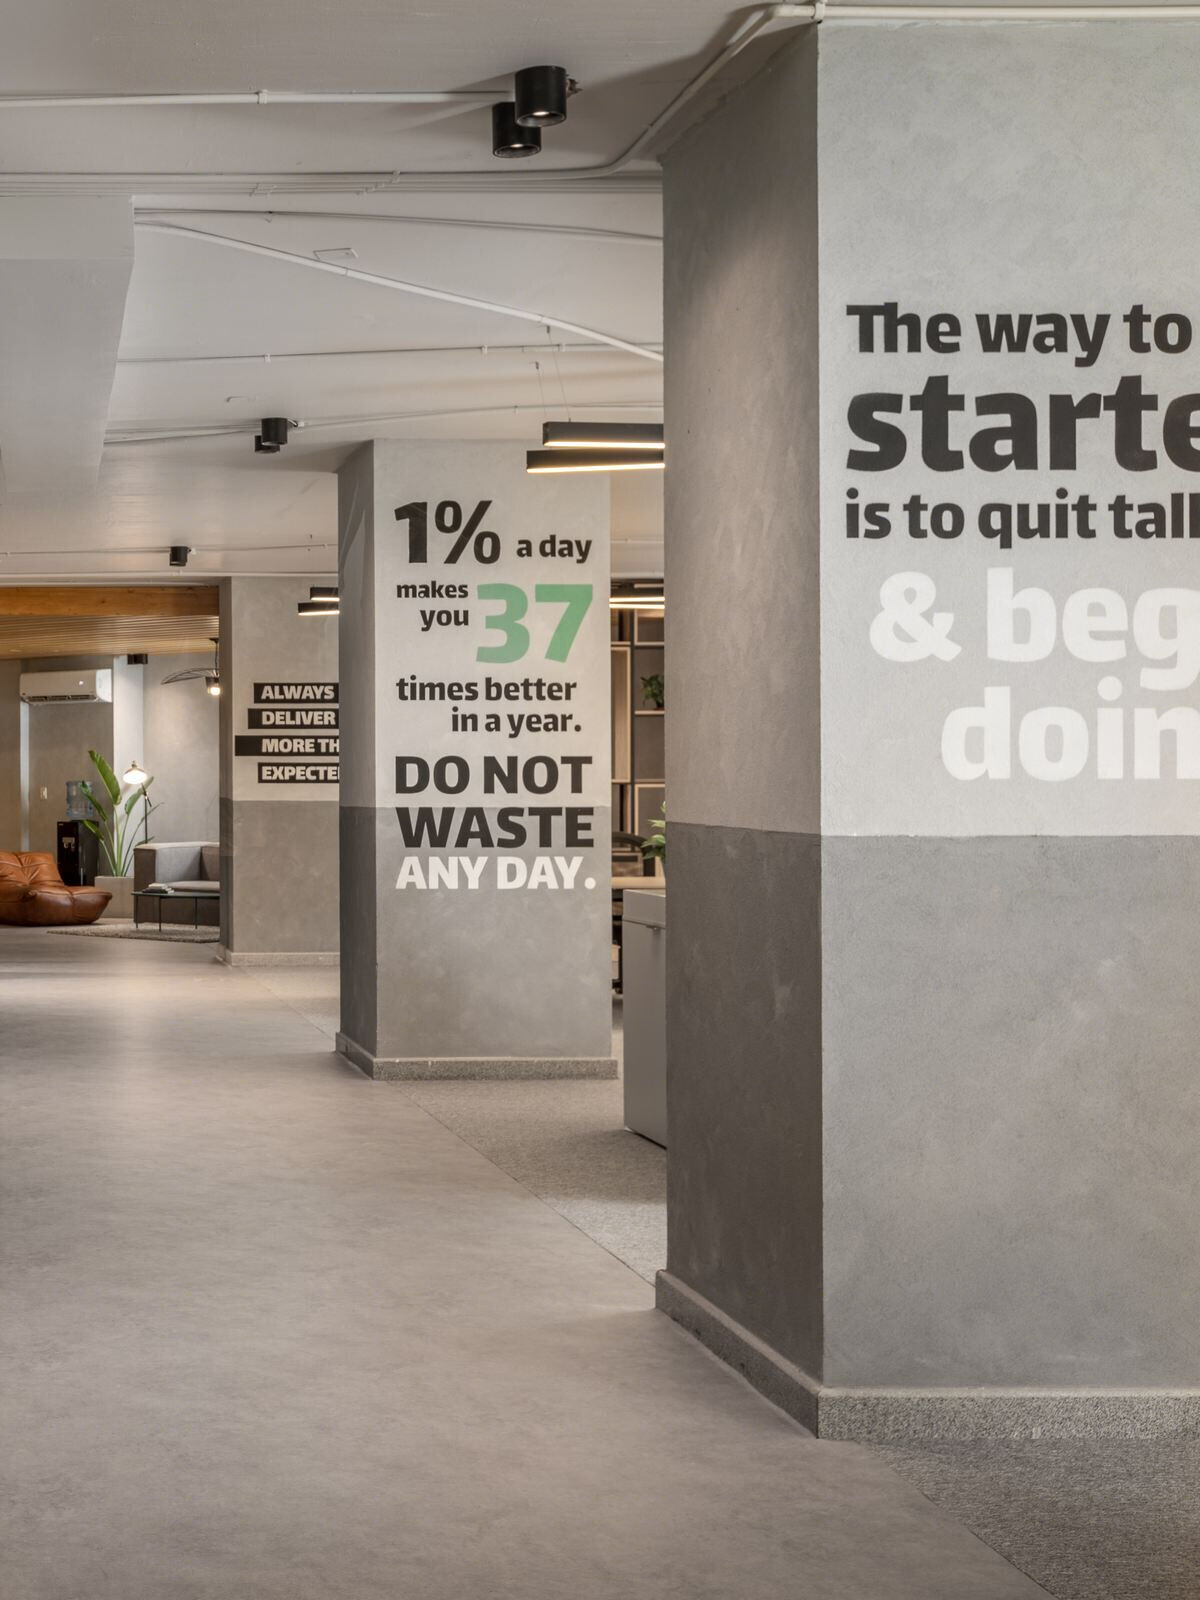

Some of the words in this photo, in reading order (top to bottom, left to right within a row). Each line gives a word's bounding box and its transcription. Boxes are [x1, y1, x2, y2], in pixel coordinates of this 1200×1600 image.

[846, 302, 961, 353] The
[976, 312, 1111, 367] way
[1123, 304, 1193, 354] to
[394, 500, 501, 564] 1%
[516, 539, 532, 558] a
[539, 534, 593, 564] day
[846, 488, 892, 539] is
[903, 494, 965, 539] to
[978, 488, 1097, 549] quit
[396, 580, 469, 599] makes
[420, 608, 469, 631] you
[476, 583, 594, 664] 37
[869, 571, 962, 662] &
[987, 567, 1200, 691] beg
[261, 685, 335, 700] ALWAYS
[396, 675, 479, 701] times
[485, 677, 577, 701] better
[262, 711, 336, 725] DELIVER
[451, 707, 478, 732] in
[485, 713, 501, 732] a
[507, 712, 582, 738] year.
[941, 676, 1200, 781] doin
[262, 738, 315, 753] MORE
[262, 766, 339, 780] EXPECTE
[395, 755, 471, 794] DO
[483, 755, 594, 794] NOT
[395, 806, 595, 849] WASTE
[395, 856, 488, 890] ANY
[497, 856, 597, 890] DAY.
